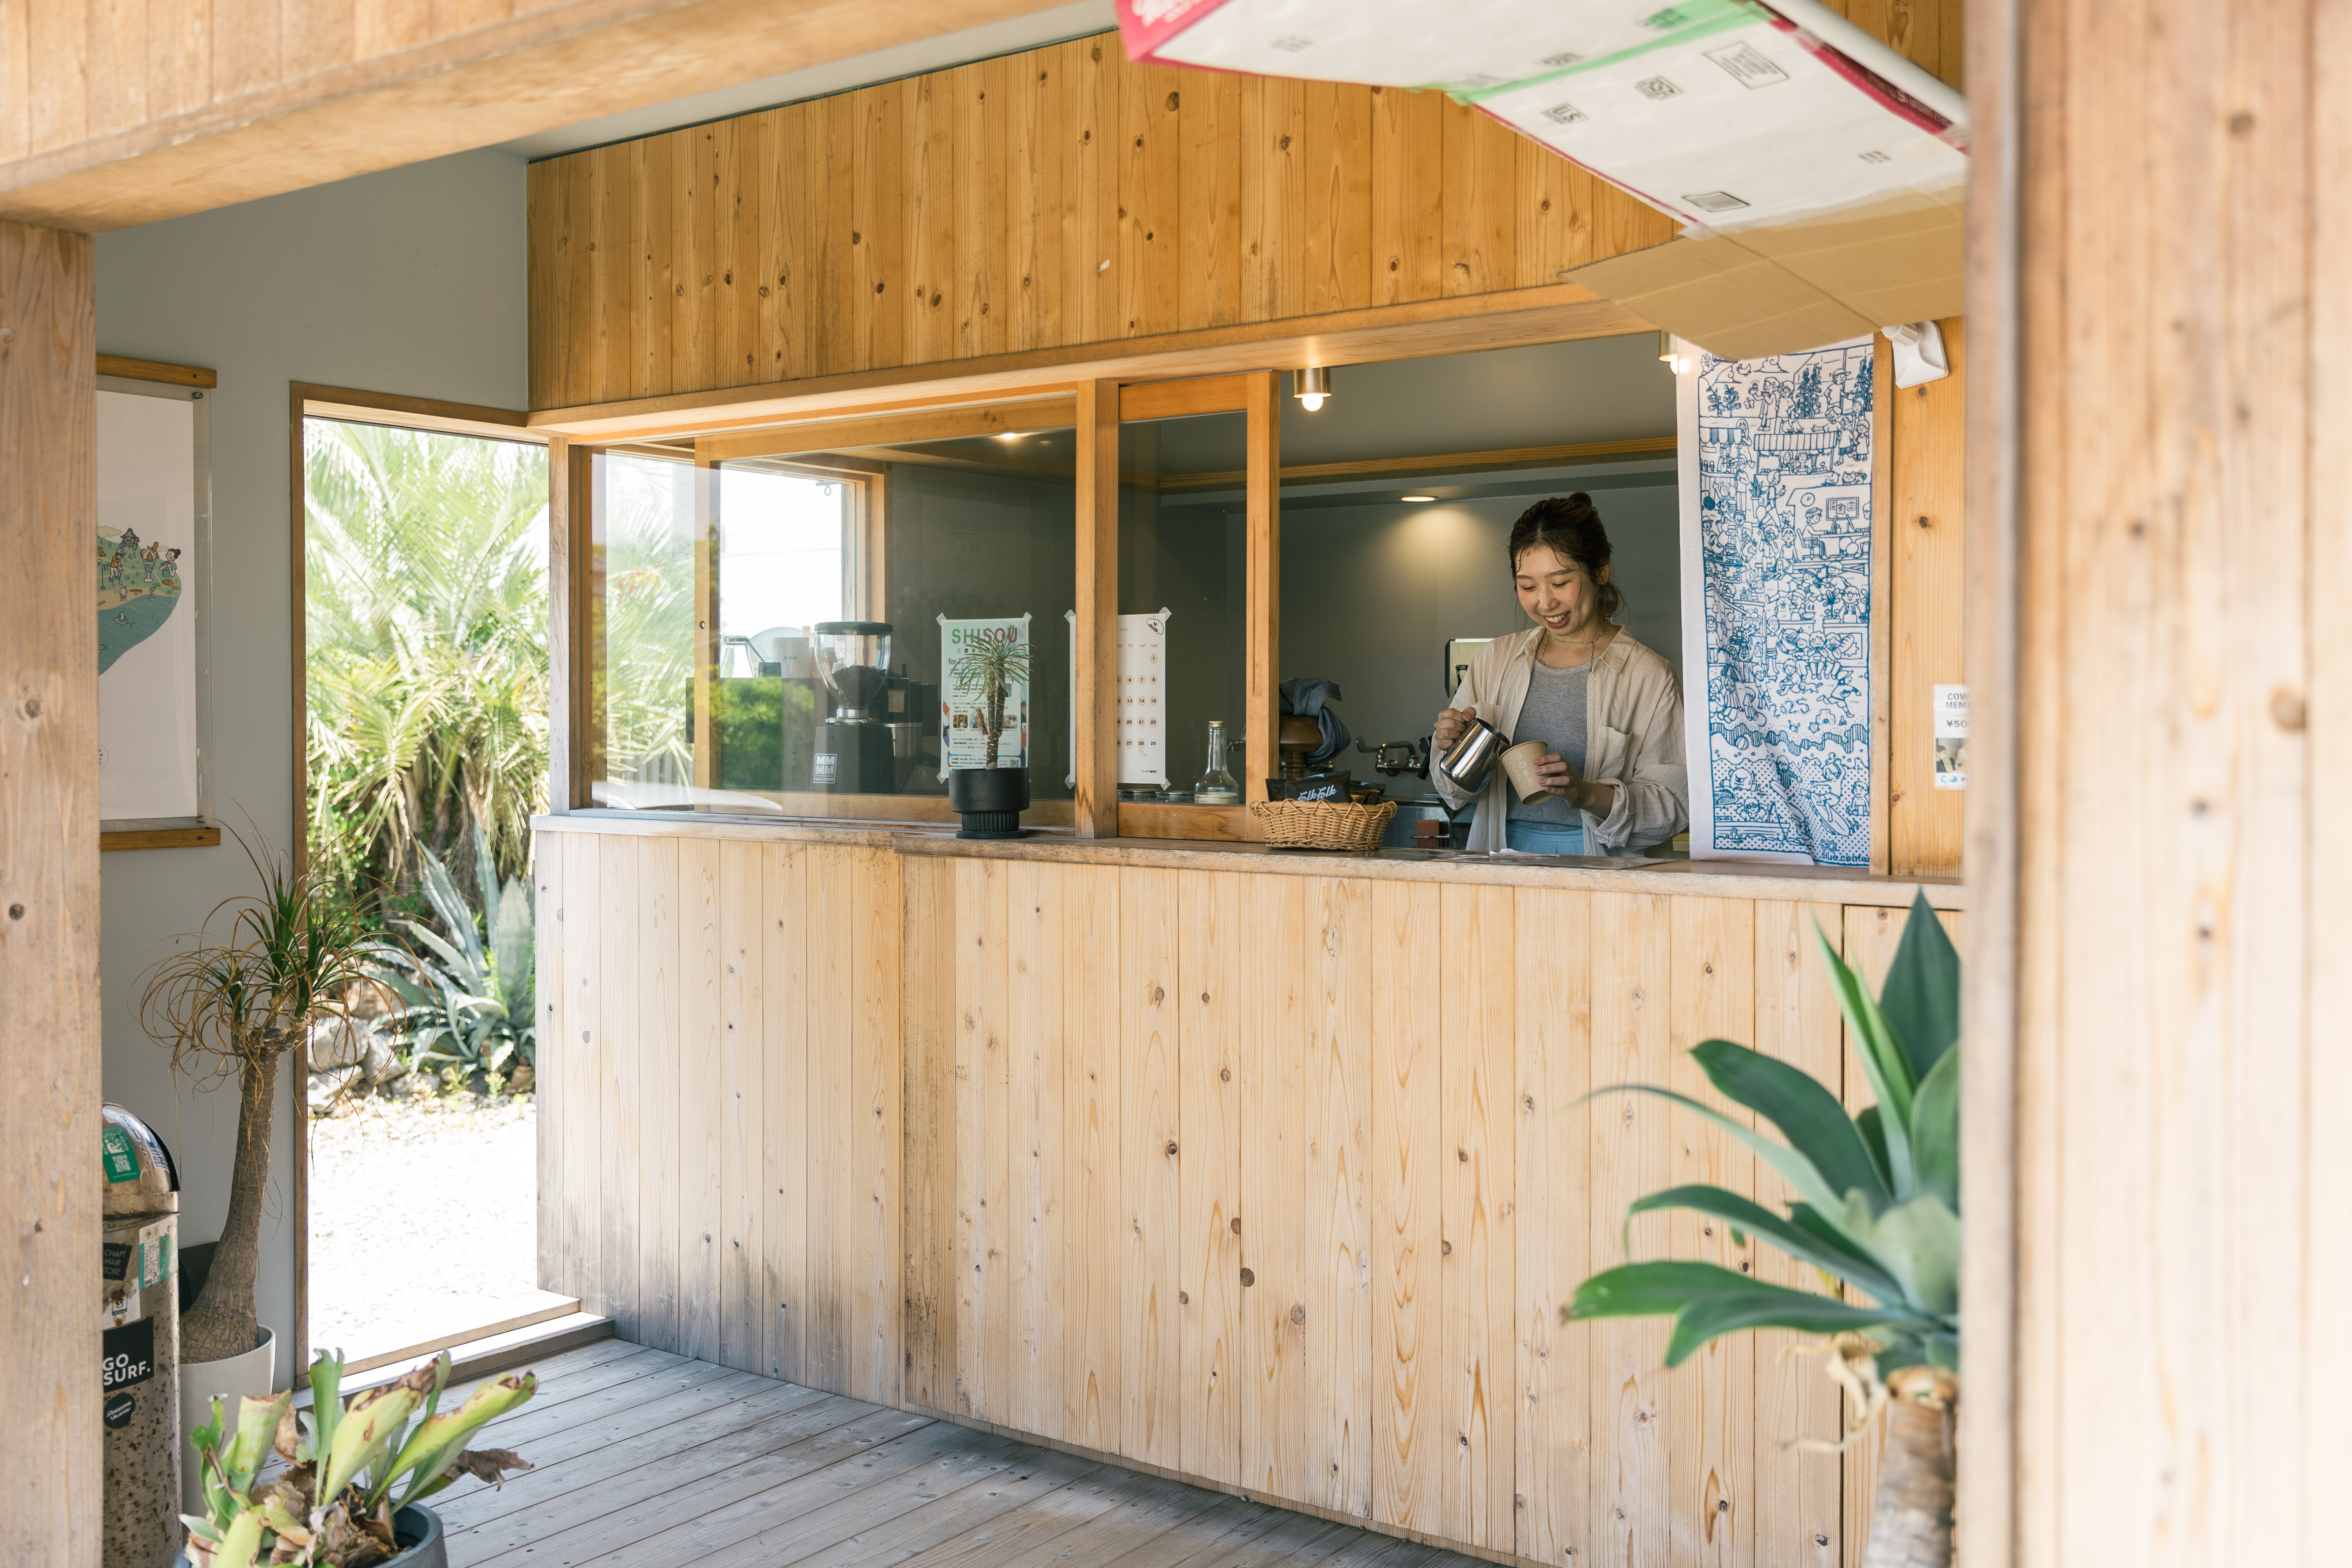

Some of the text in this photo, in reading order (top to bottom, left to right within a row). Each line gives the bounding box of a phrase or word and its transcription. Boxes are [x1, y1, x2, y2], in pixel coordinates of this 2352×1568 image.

[952, 627, 1018, 644] SHISOU
[1769, 699, 1809, 717] 2025
[816, 756, 835, 765] MM
[104, 1249, 127, 1258] CHAPT
[104, 1258, 122, 1267] HAIR
[103, 1267, 122, 1276] TORE
[103, 1354, 129, 1372] GO
[103, 1361, 151, 1386] SURF.
